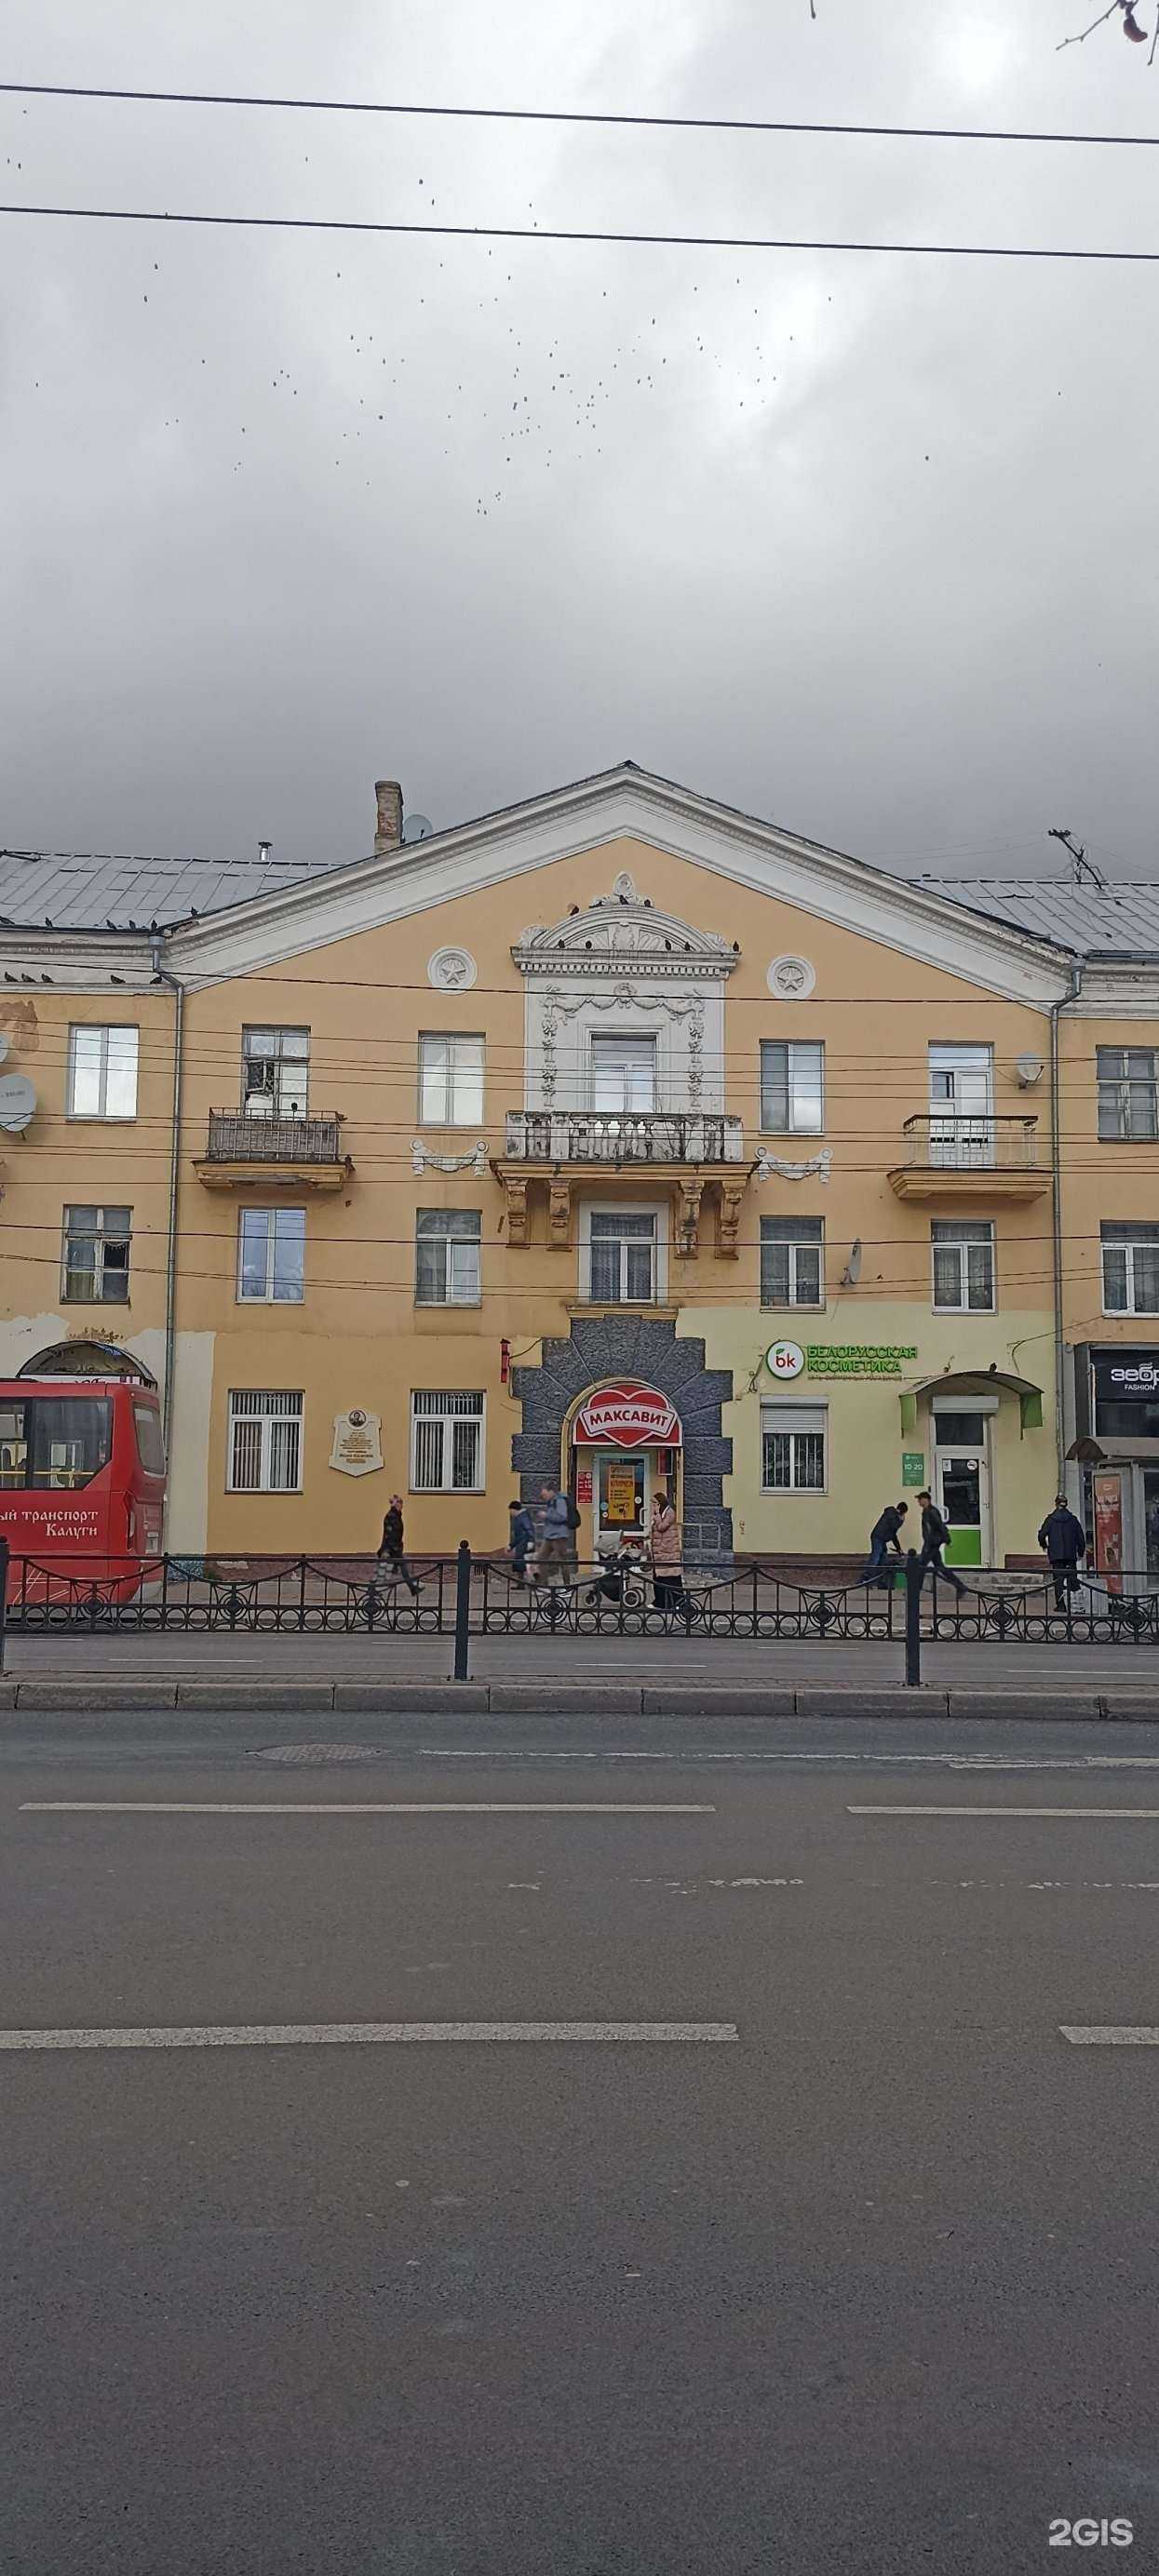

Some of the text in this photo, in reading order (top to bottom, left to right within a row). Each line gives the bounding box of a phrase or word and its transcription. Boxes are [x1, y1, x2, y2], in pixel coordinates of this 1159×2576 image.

[807, 1346, 918, 1359] БЕЛОРУССКАЯ
[807, 1360, 902, 1373] КОСМЕТИКА
[589, 1410, 667, 1427] МАКСАВИТ
[21, 1510, 98, 1523] транспорт
[46, 1523, 98, 1539] Калуги
